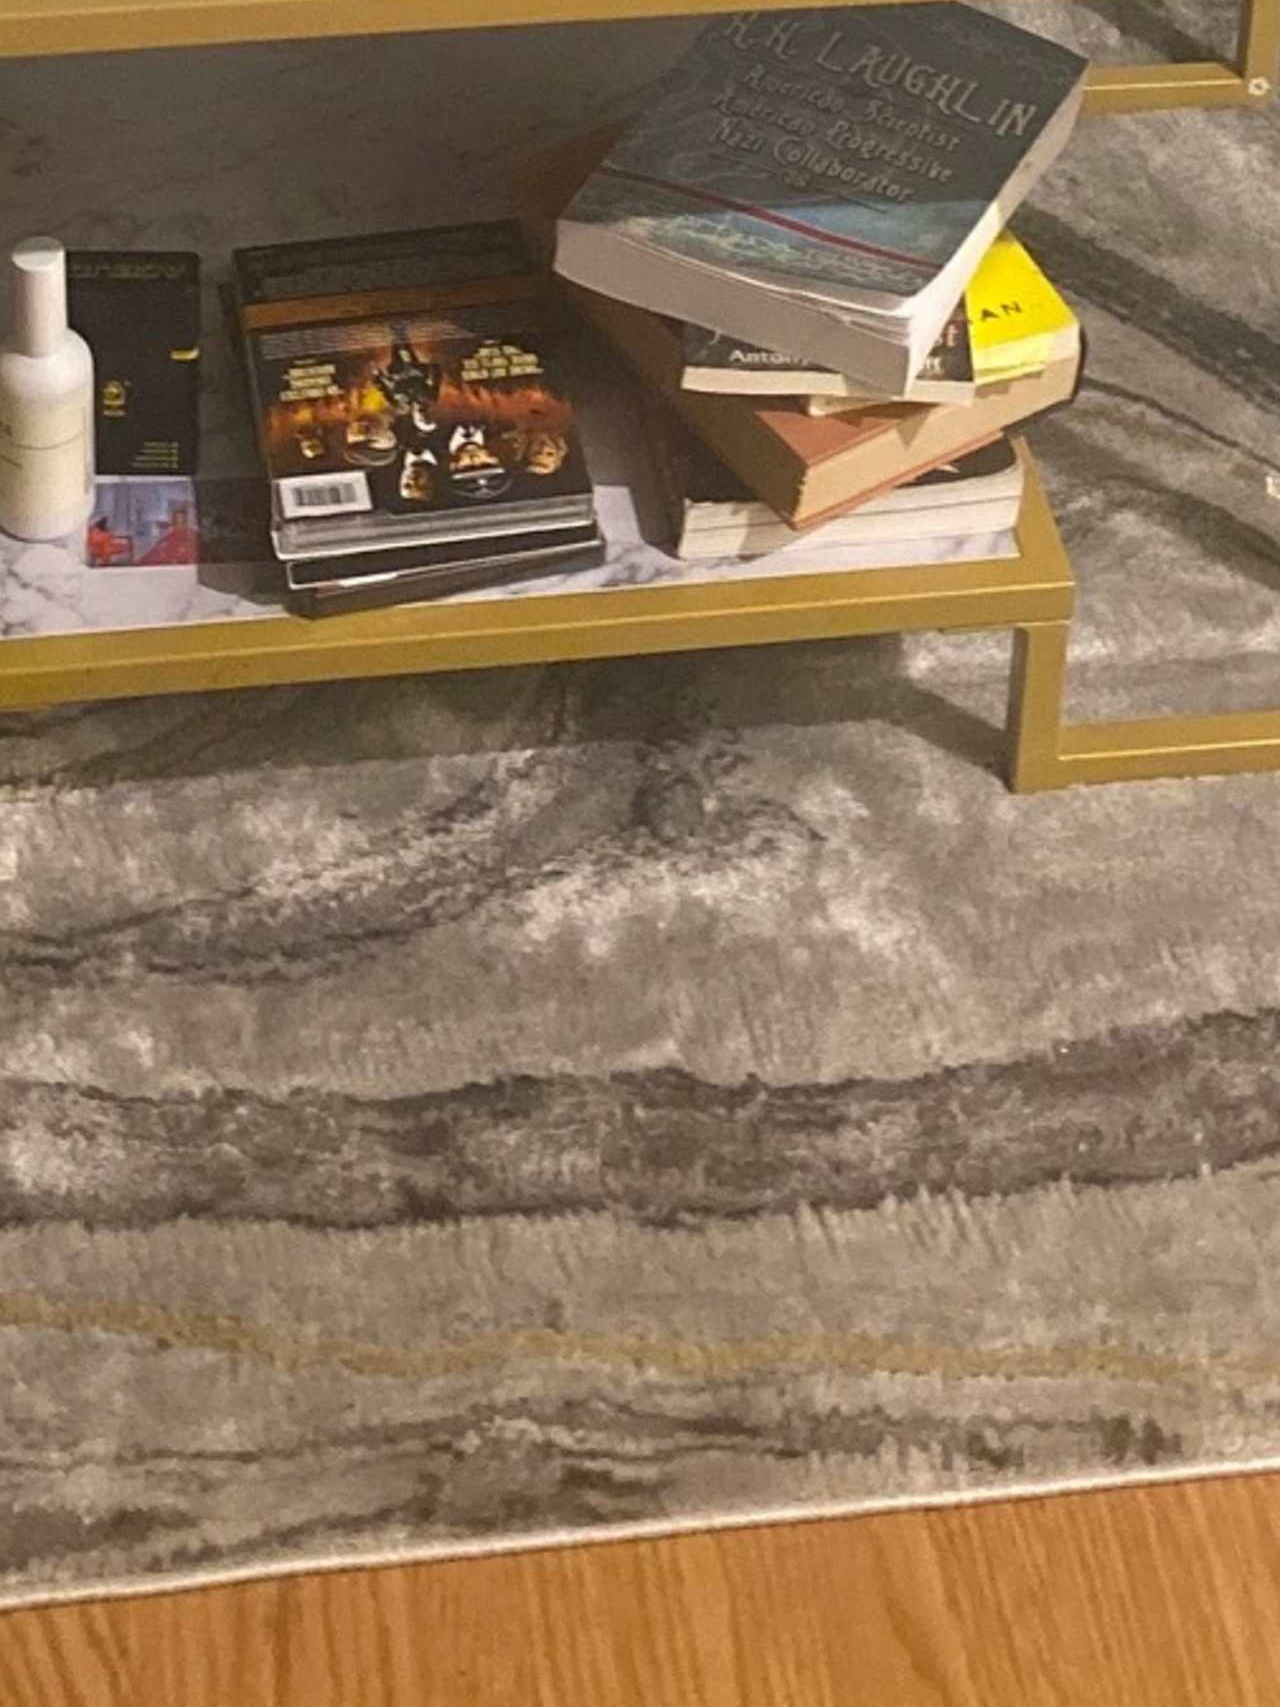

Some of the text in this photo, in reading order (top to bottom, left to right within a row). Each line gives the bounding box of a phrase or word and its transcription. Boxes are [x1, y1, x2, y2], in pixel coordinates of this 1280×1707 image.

[815, 30, 1037, 139] LAUGHLIN
[708, 113, 918, 204] Nazi Collaborator
